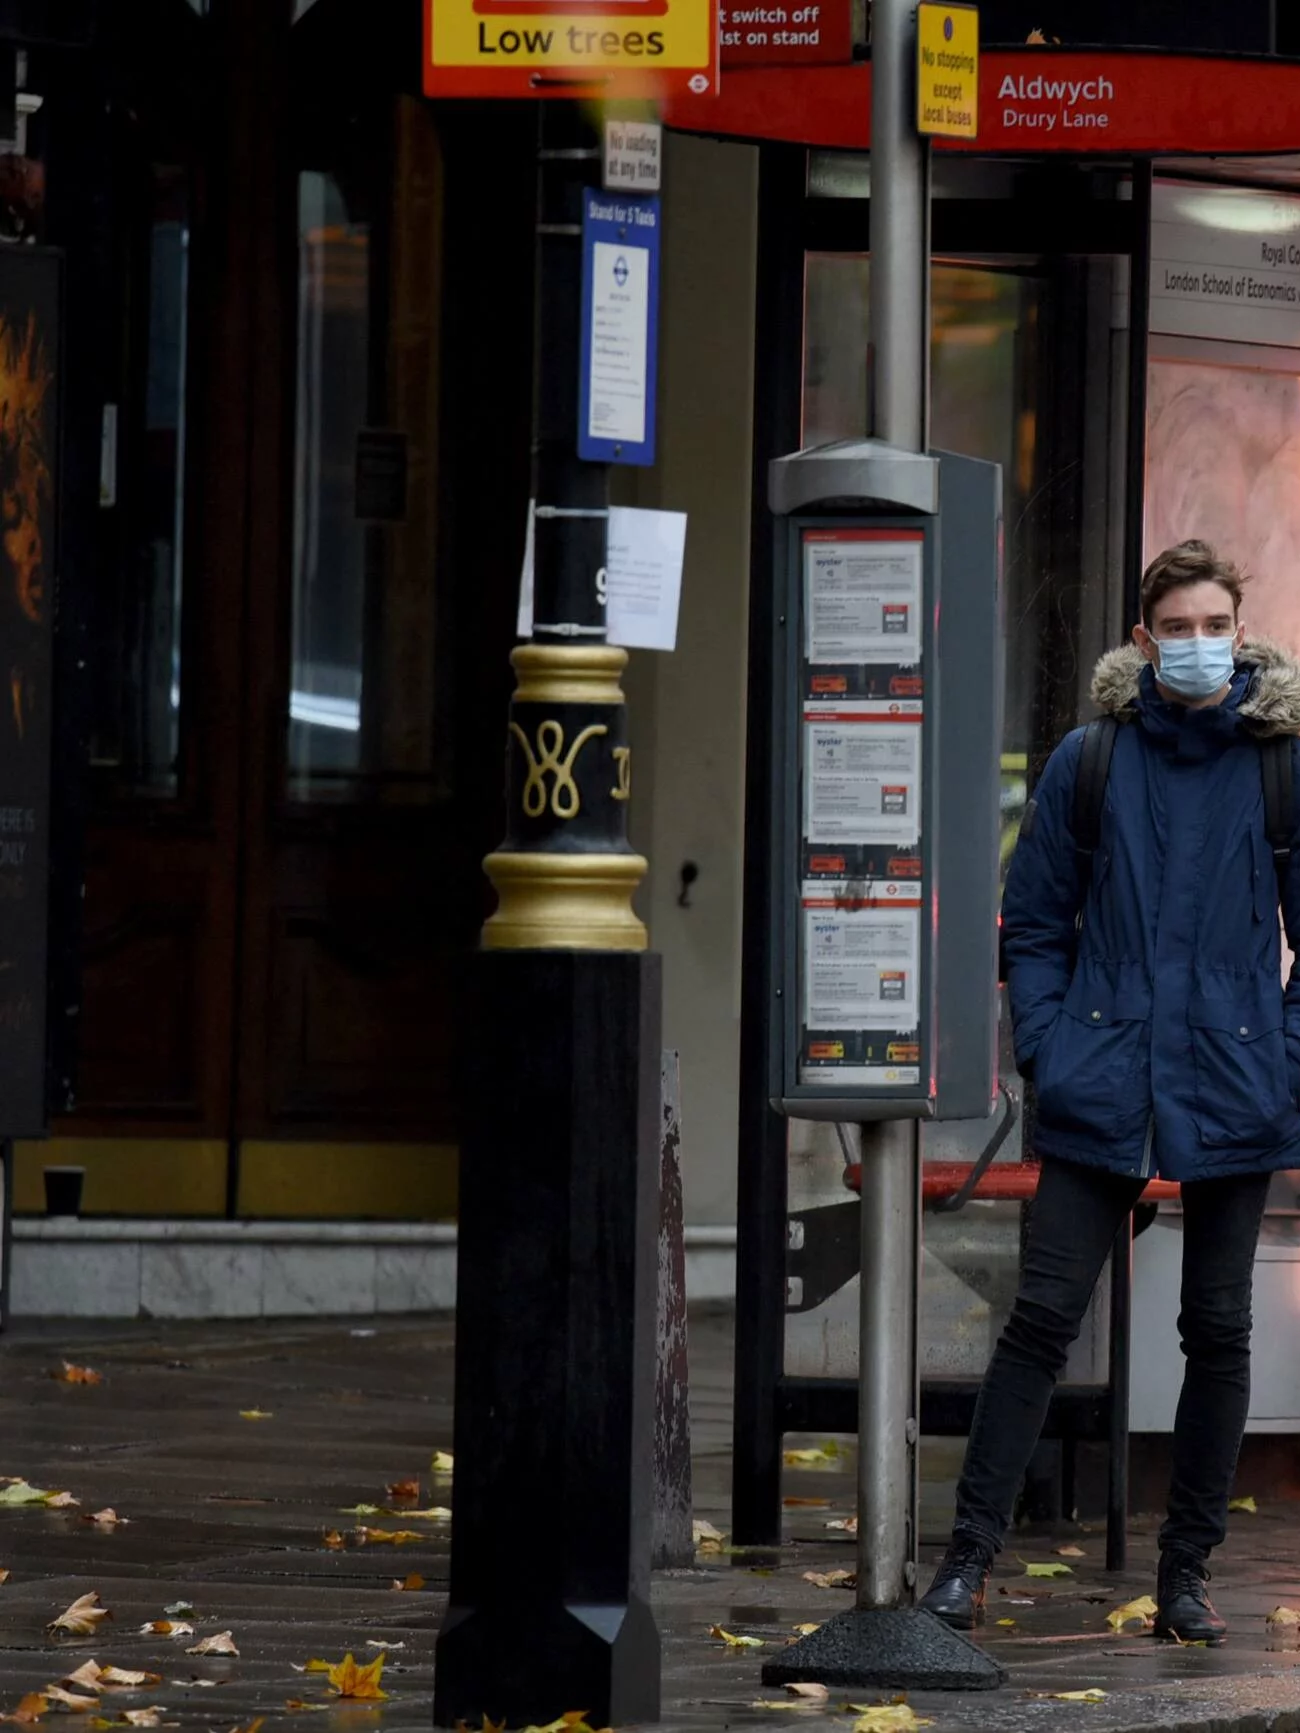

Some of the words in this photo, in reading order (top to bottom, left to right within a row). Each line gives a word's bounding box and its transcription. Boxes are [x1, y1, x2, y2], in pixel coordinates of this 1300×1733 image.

[732, 7, 787, 23] switch
[792, 7, 820, 23] off
[478, 22, 554, 54] Low
[567, 24, 664, 57] trees
[746, 33, 767, 46] on
[772, 29, 820, 46] stand
[922, 47, 934, 66] No
[937, 51, 975, 74] stopping
[933, 83, 962, 101] except
[997, 75, 1114, 105] Aldwych
[923, 105, 945, 124] local
[946, 109, 972, 126] buses
[1003, 109, 1056, 131] Drury
[1063, 110, 1109, 128] Lane
[610, 132, 623, 149] No
[626, 133, 657, 157] loading
[608, 160, 618, 176] at
[621, 162, 636, 181] any
[638, 161, 658, 179] time
[1261, 242, 1286, 267] Royal
[1165, 270, 1200, 293] London
[1202, 273, 1233, 297] School
[1235, 276, 1246, 297] of
[1247, 279, 1297, 302] Economics
